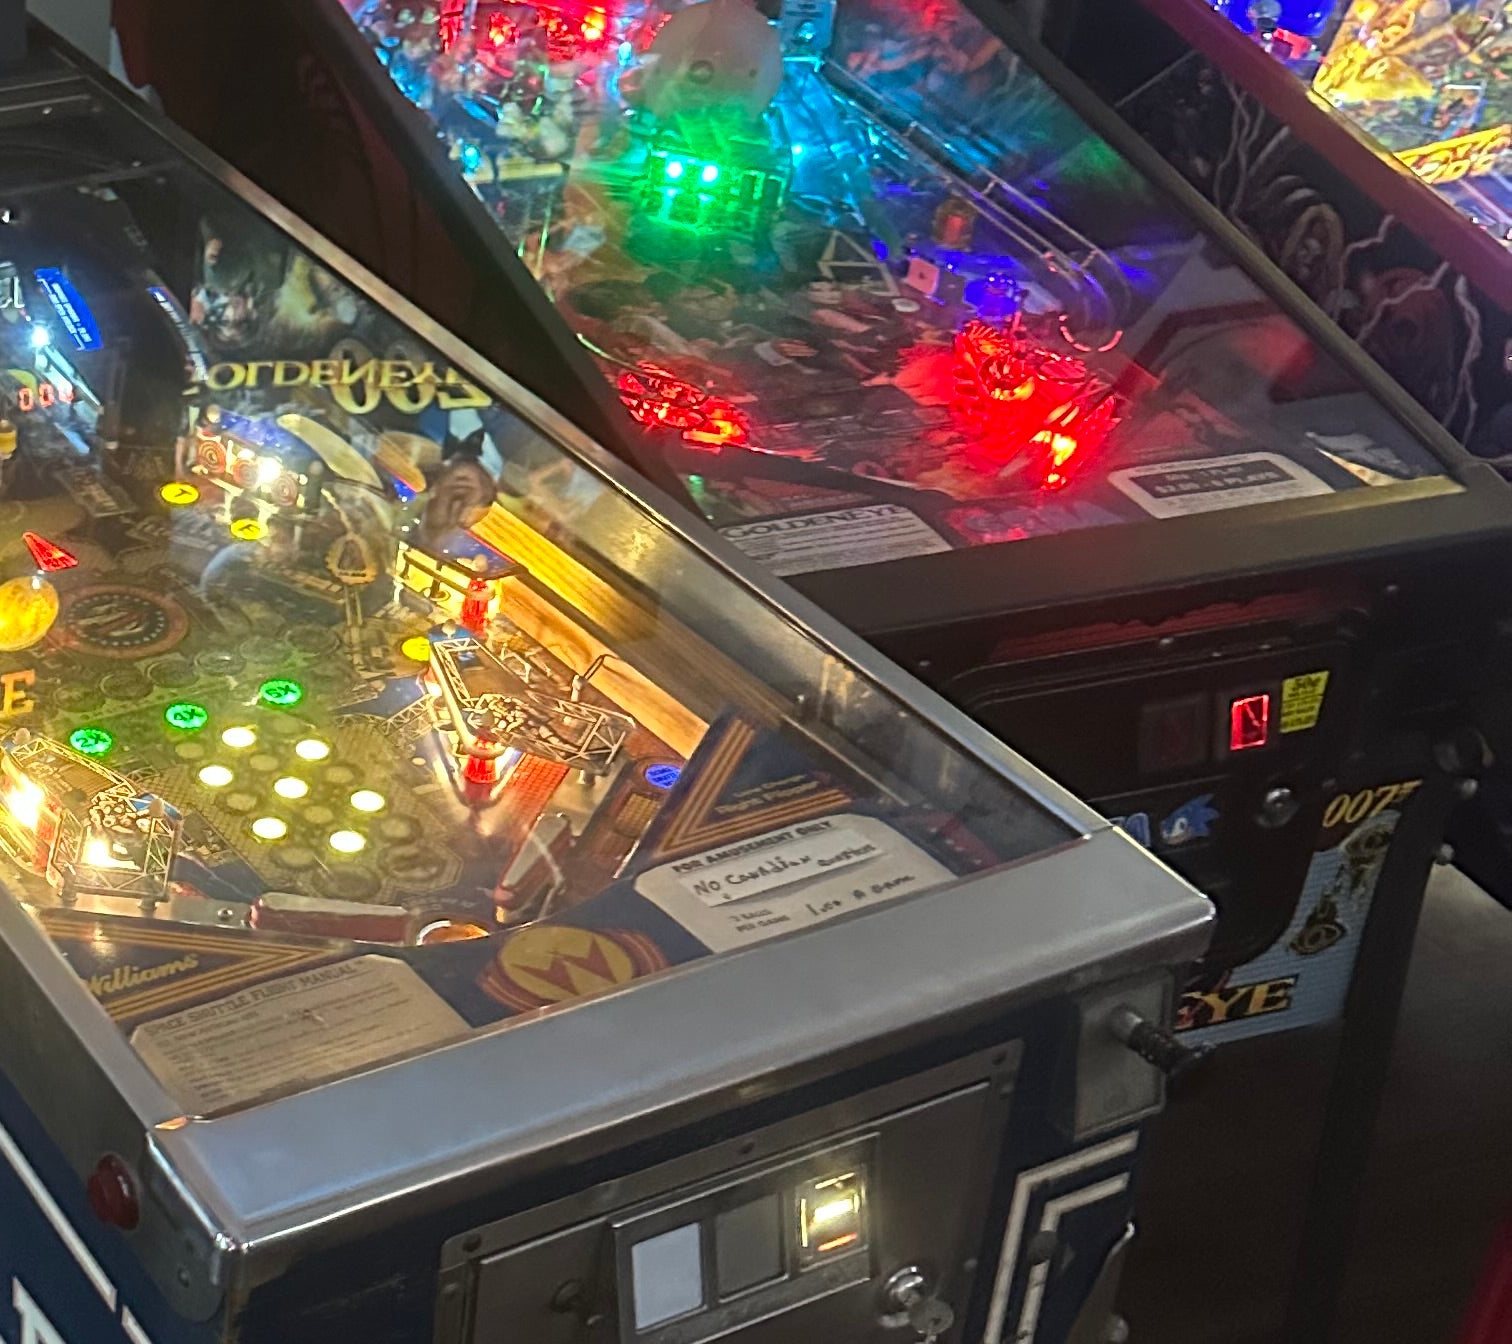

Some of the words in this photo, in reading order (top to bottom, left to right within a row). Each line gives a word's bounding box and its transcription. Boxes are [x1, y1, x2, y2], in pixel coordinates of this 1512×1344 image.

[1322, 779, 1422, 829] 007
[672, 859, 703, 873] FOR
[706, 831, 795, 863] AMUSEMENT
[796, 820, 833, 838] ONLY
[188, 994, 248, 1024] SHUTTLE
[252, 977, 300, 1004] FLIGHT
